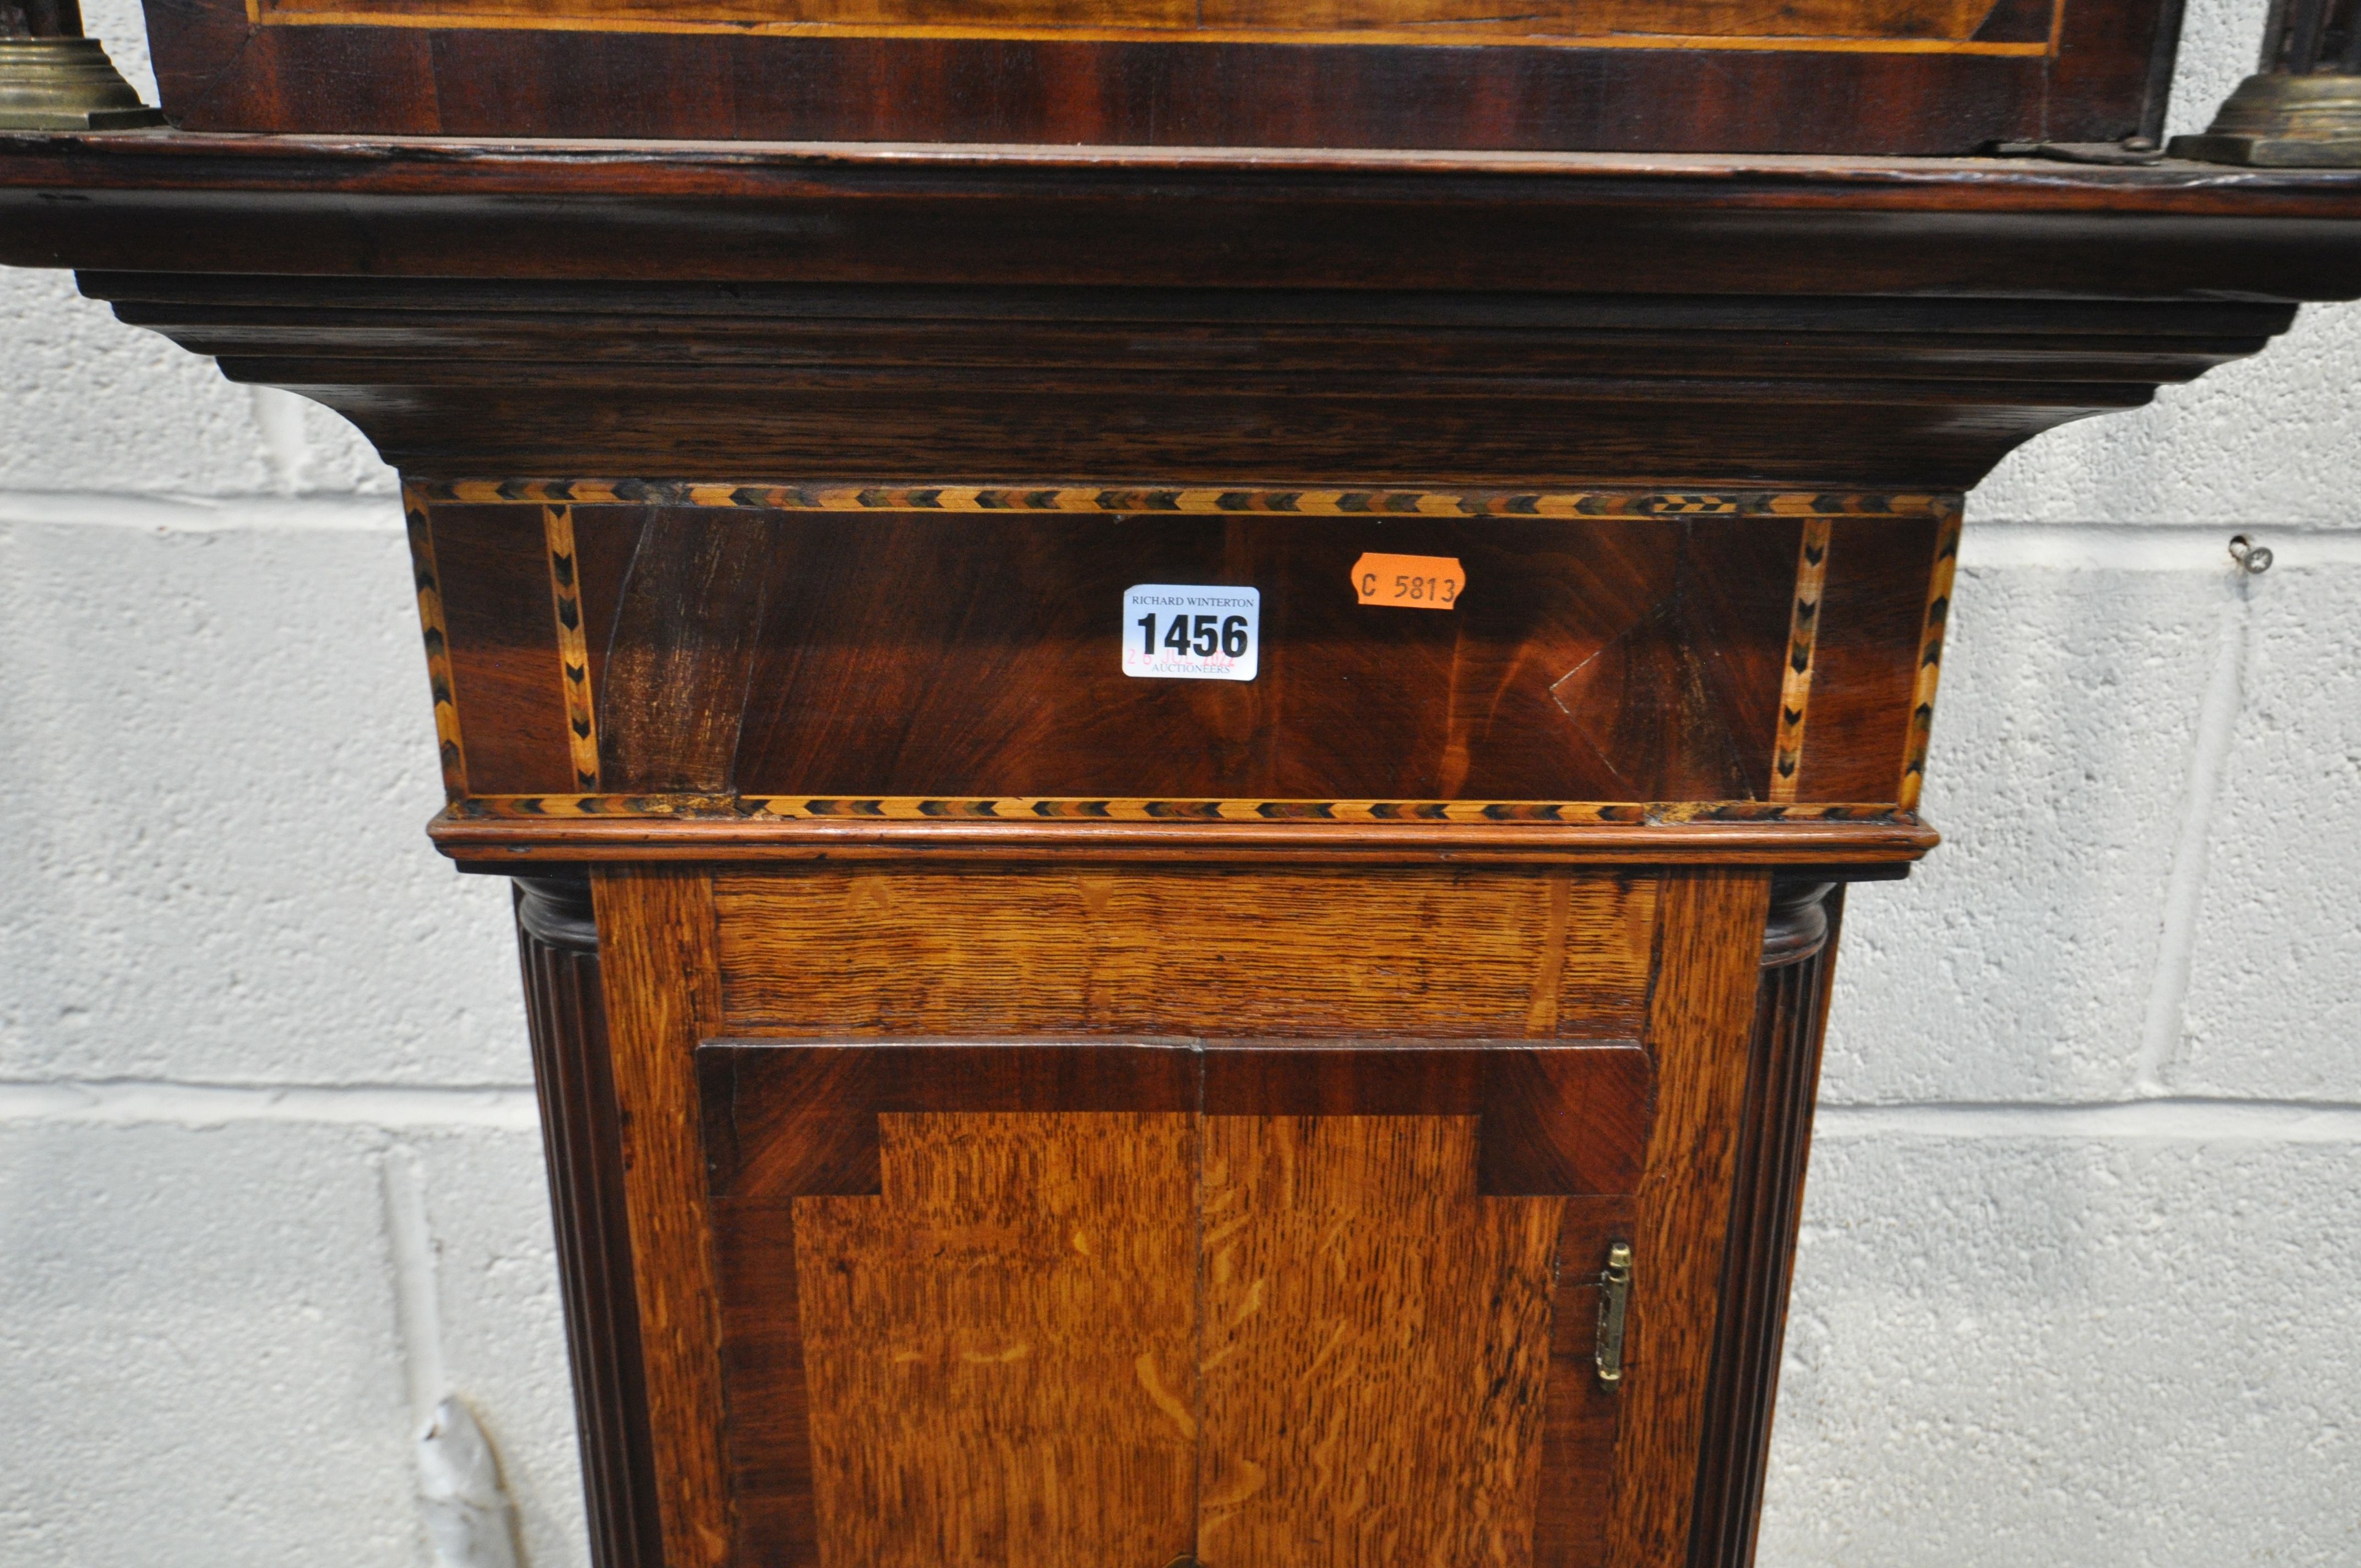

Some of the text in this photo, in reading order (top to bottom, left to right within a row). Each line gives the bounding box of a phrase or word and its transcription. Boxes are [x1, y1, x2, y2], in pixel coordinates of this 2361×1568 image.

[1362, 573, 1455, 602] C 5813
[1132, 596, 1254, 607] RICHARD WINTERTON
[1138, 613, 1248, 657] 1456
[1152, 664, 1230, 674] AUCTIONEERS
